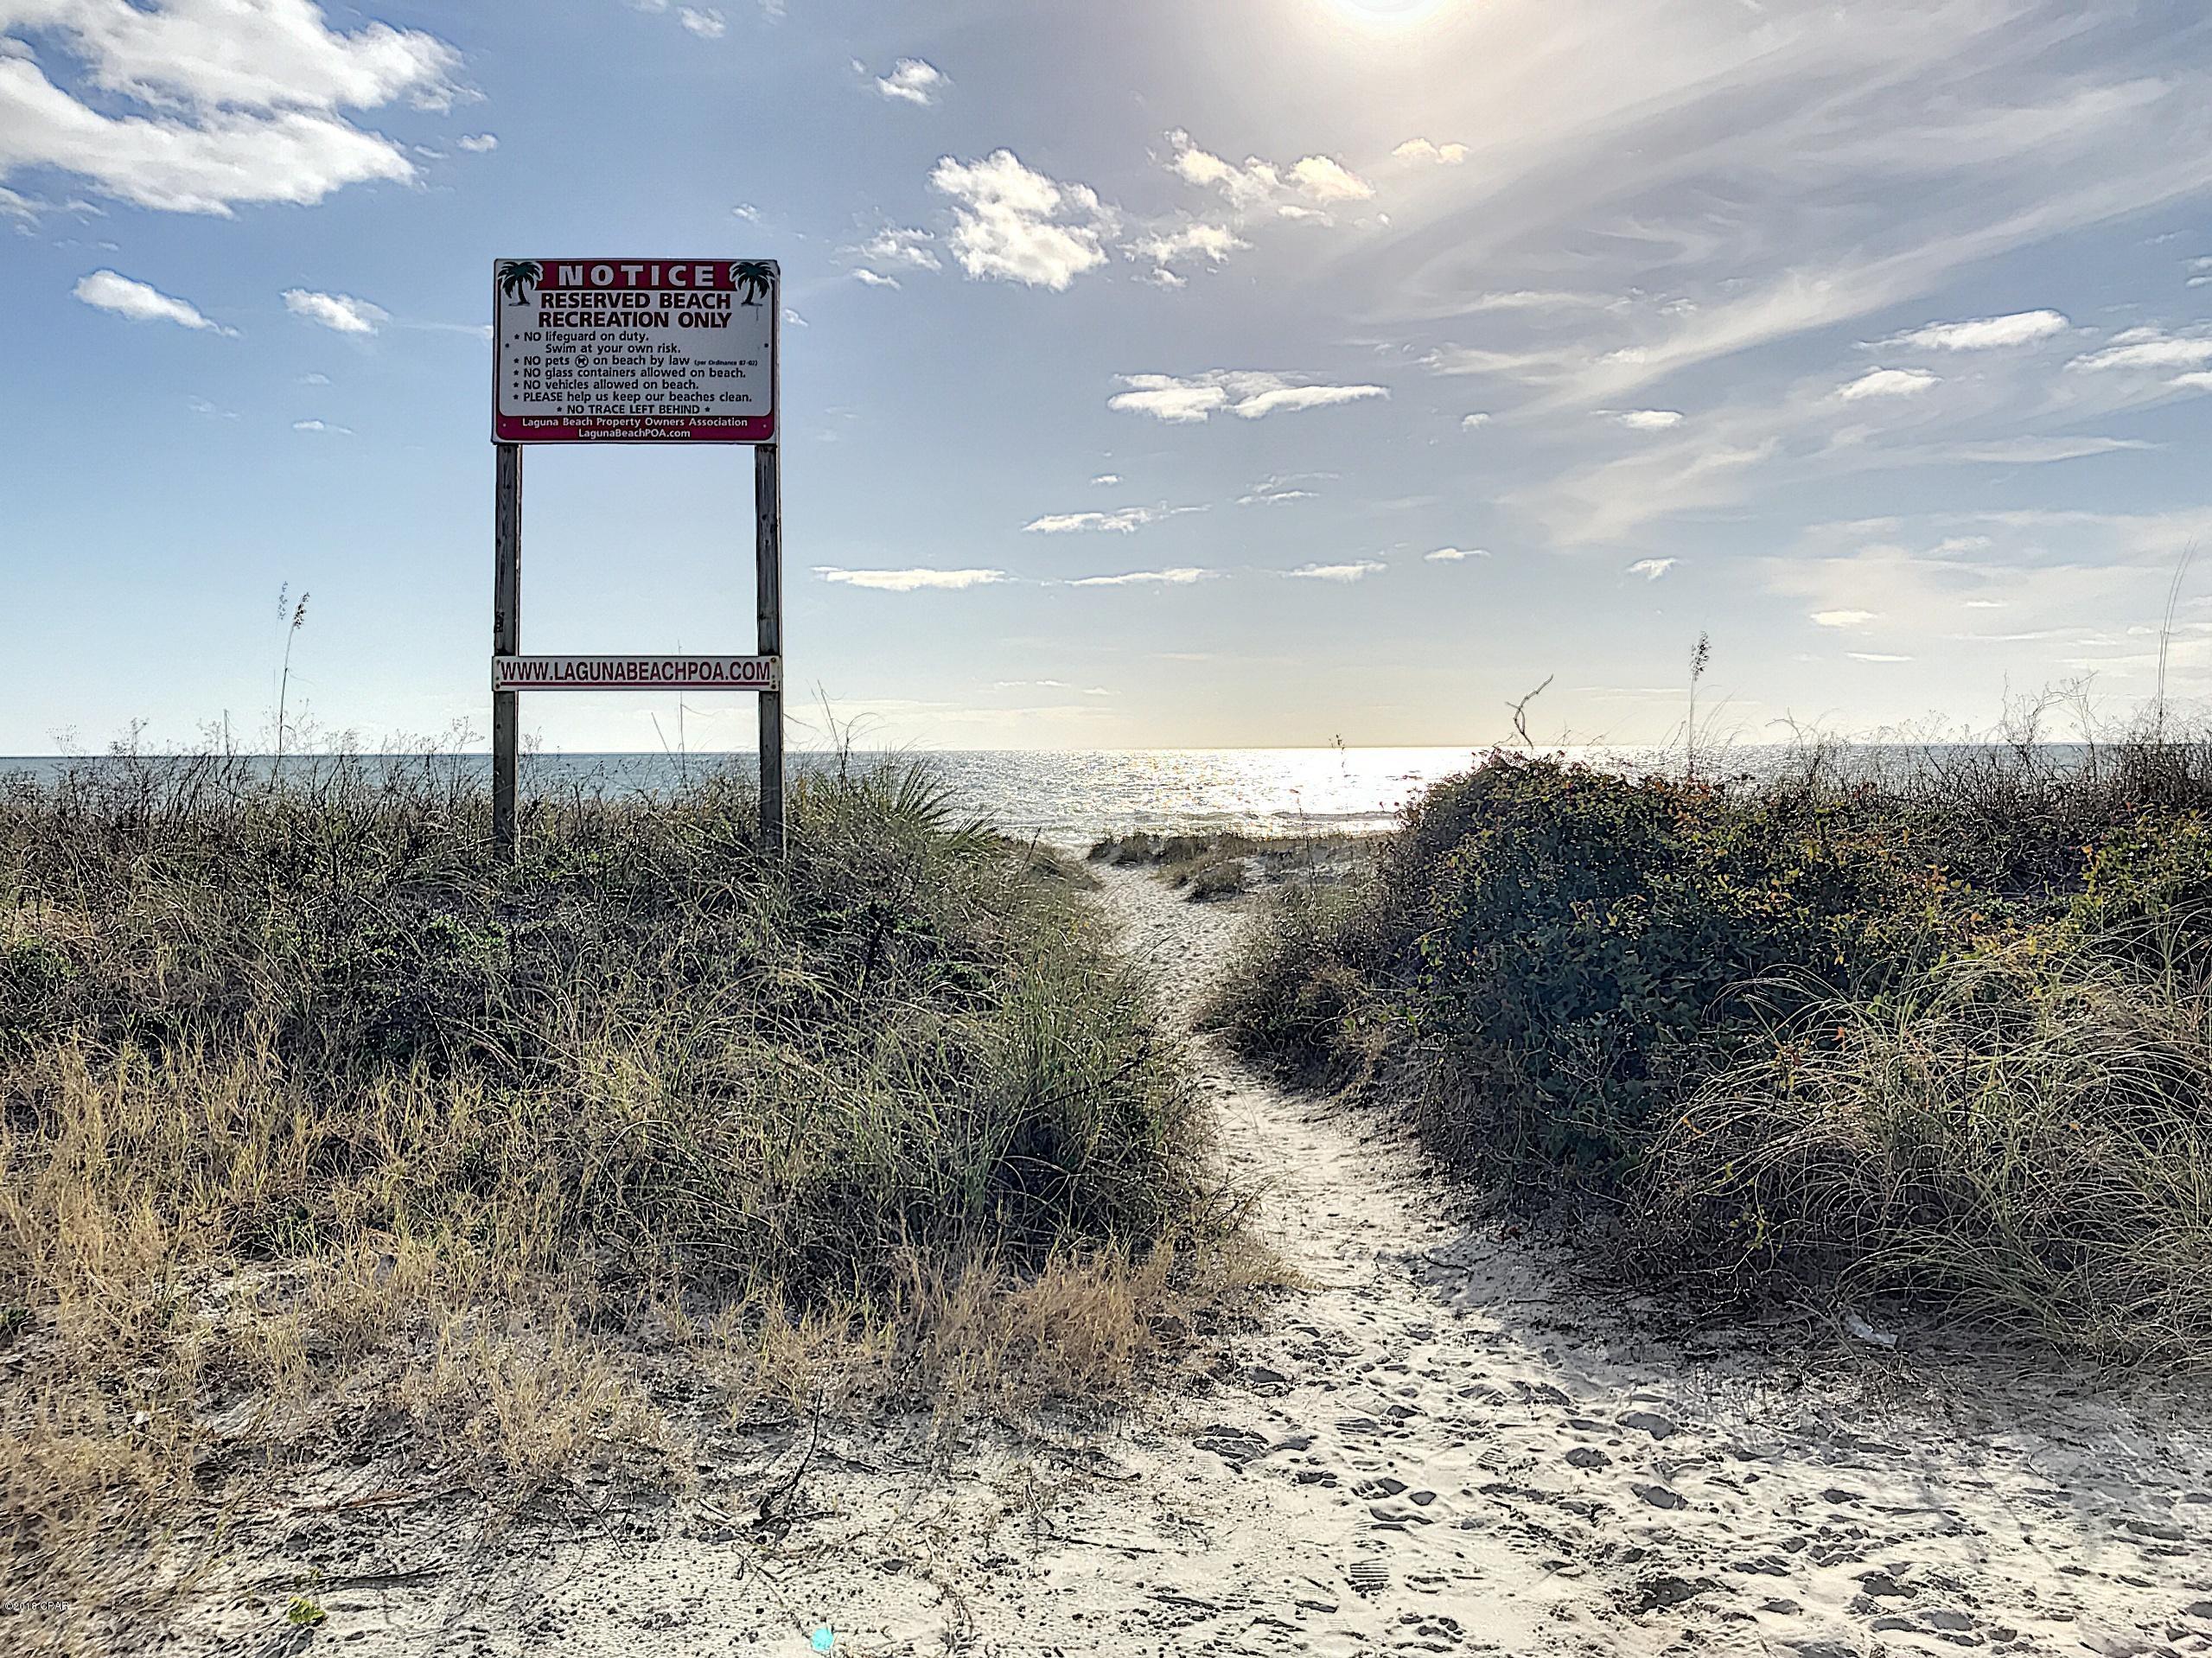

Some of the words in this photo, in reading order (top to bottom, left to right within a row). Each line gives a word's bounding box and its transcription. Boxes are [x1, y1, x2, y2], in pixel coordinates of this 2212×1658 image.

[558, 265, 714, 287] NOTICE
[540, 293, 651, 309] RESERVED
[660, 293, 730, 309] BEACH
[539, 312, 669, 328] RECREATION
[678, 312, 732, 328] ONLY
[523, 332, 541, 341] NO
[545, 331, 596, 344] lifeguard
[619, 331, 649, 344] duty.
[545, 344, 577, 354] Swim
[581, 345, 593, 354] at
[597, 346, 623, 356] your
[657, 343, 681, 354] risk.
[523, 356, 541, 366] NO
[545, 357, 570, 368] pets
[612, 355, 646, 366] beach
[650, 355, 665, 368] by
[669, 355, 690, 366] law
[523, 368, 541, 378] NO
[545, 367, 573, 380] glass
[577, 368, 636, 378] containers
[641, 367, 686, 378] allowed
[709, 367, 746, 378] beach.
[523, 380, 541, 390] NO
[545, 379, 589, 390] vehicles
[593, 379, 639, 390] allowed
[662, 379, 699, 390] beach.
[523, 392, 563, 402] PLEASE
[567, 392, 591, 405] help
[613, 392, 641, 405] keep
[669, 392, 715, 402] beaches
[719, 392, 752, 402] clean.
[567, 405, 584, 414] NO
[588, 405, 625, 414] TRACE
[629, 405, 655, 414] LEFT
[659, 405, 700, 414] BEHIND
[522, 418, 558, 428] Laguna
[563, 417, 593, 426] Beach
[596, 418, 641, 429] Property
[645, 418, 685, 427] Owners
[689, 417, 748, 427] Association
[578, 429, 691, 439] LagunaBeachPOA.com
[500, 661, 770, 681] WWW.LAGUNABEACHPOA.COM
